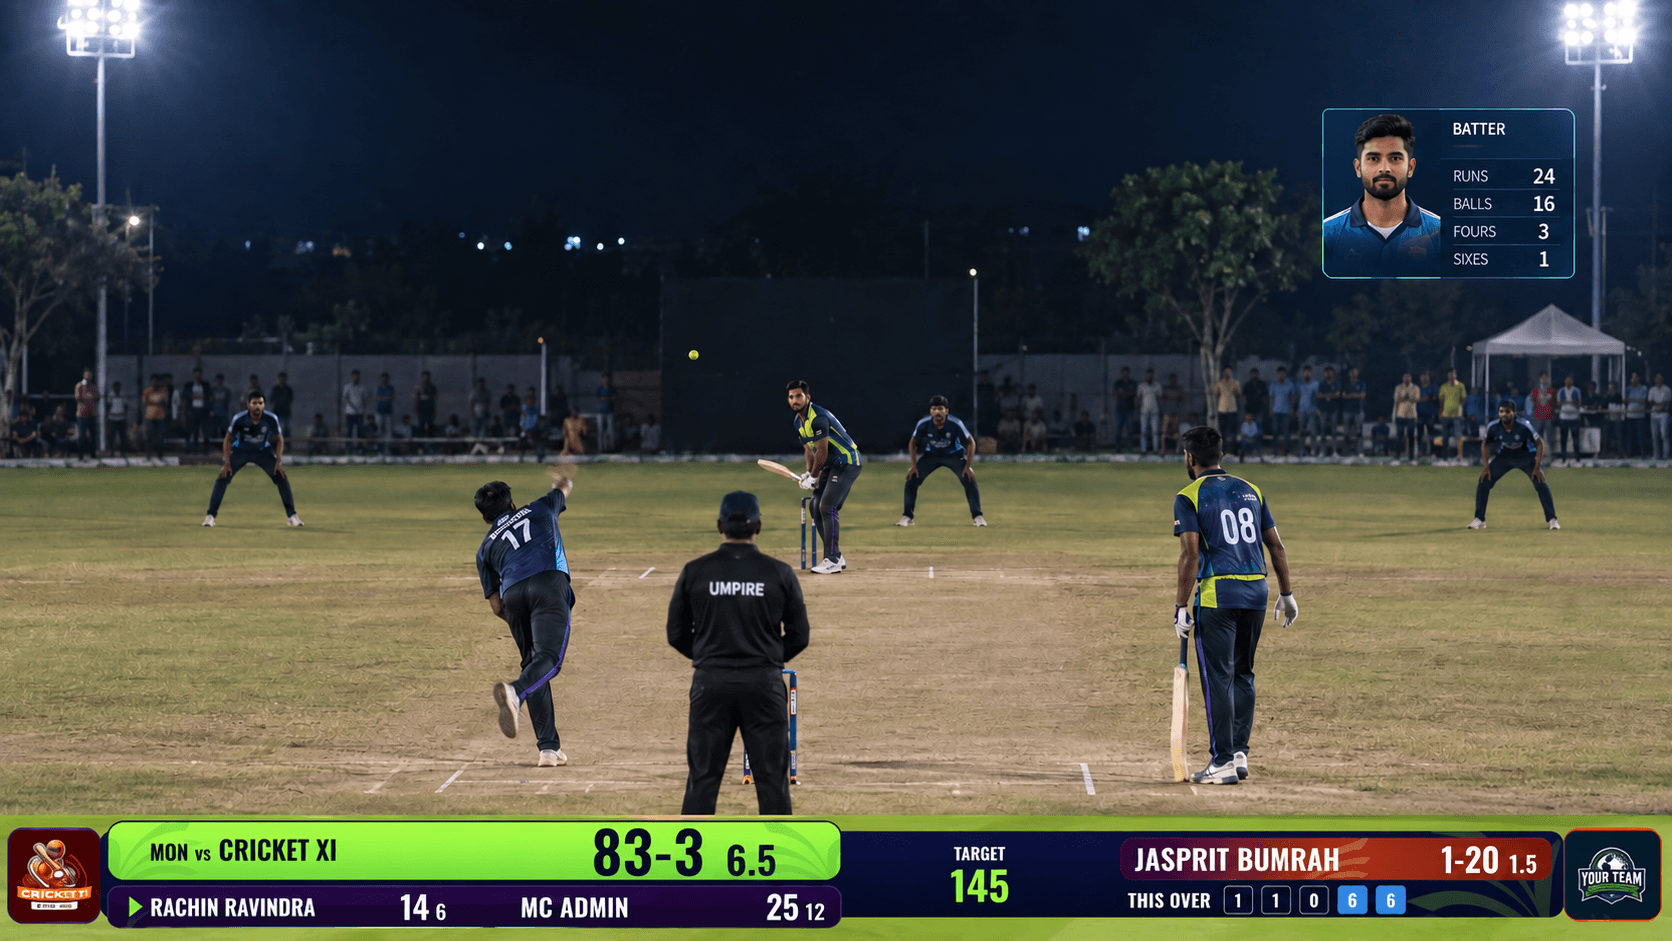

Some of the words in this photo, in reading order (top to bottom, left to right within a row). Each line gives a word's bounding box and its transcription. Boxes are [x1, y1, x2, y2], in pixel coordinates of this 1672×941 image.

[501, 517, 532, 551] 17
[1220, 507, 1257, 545] 08
[709, 581, 765, 597] UMPIRE
